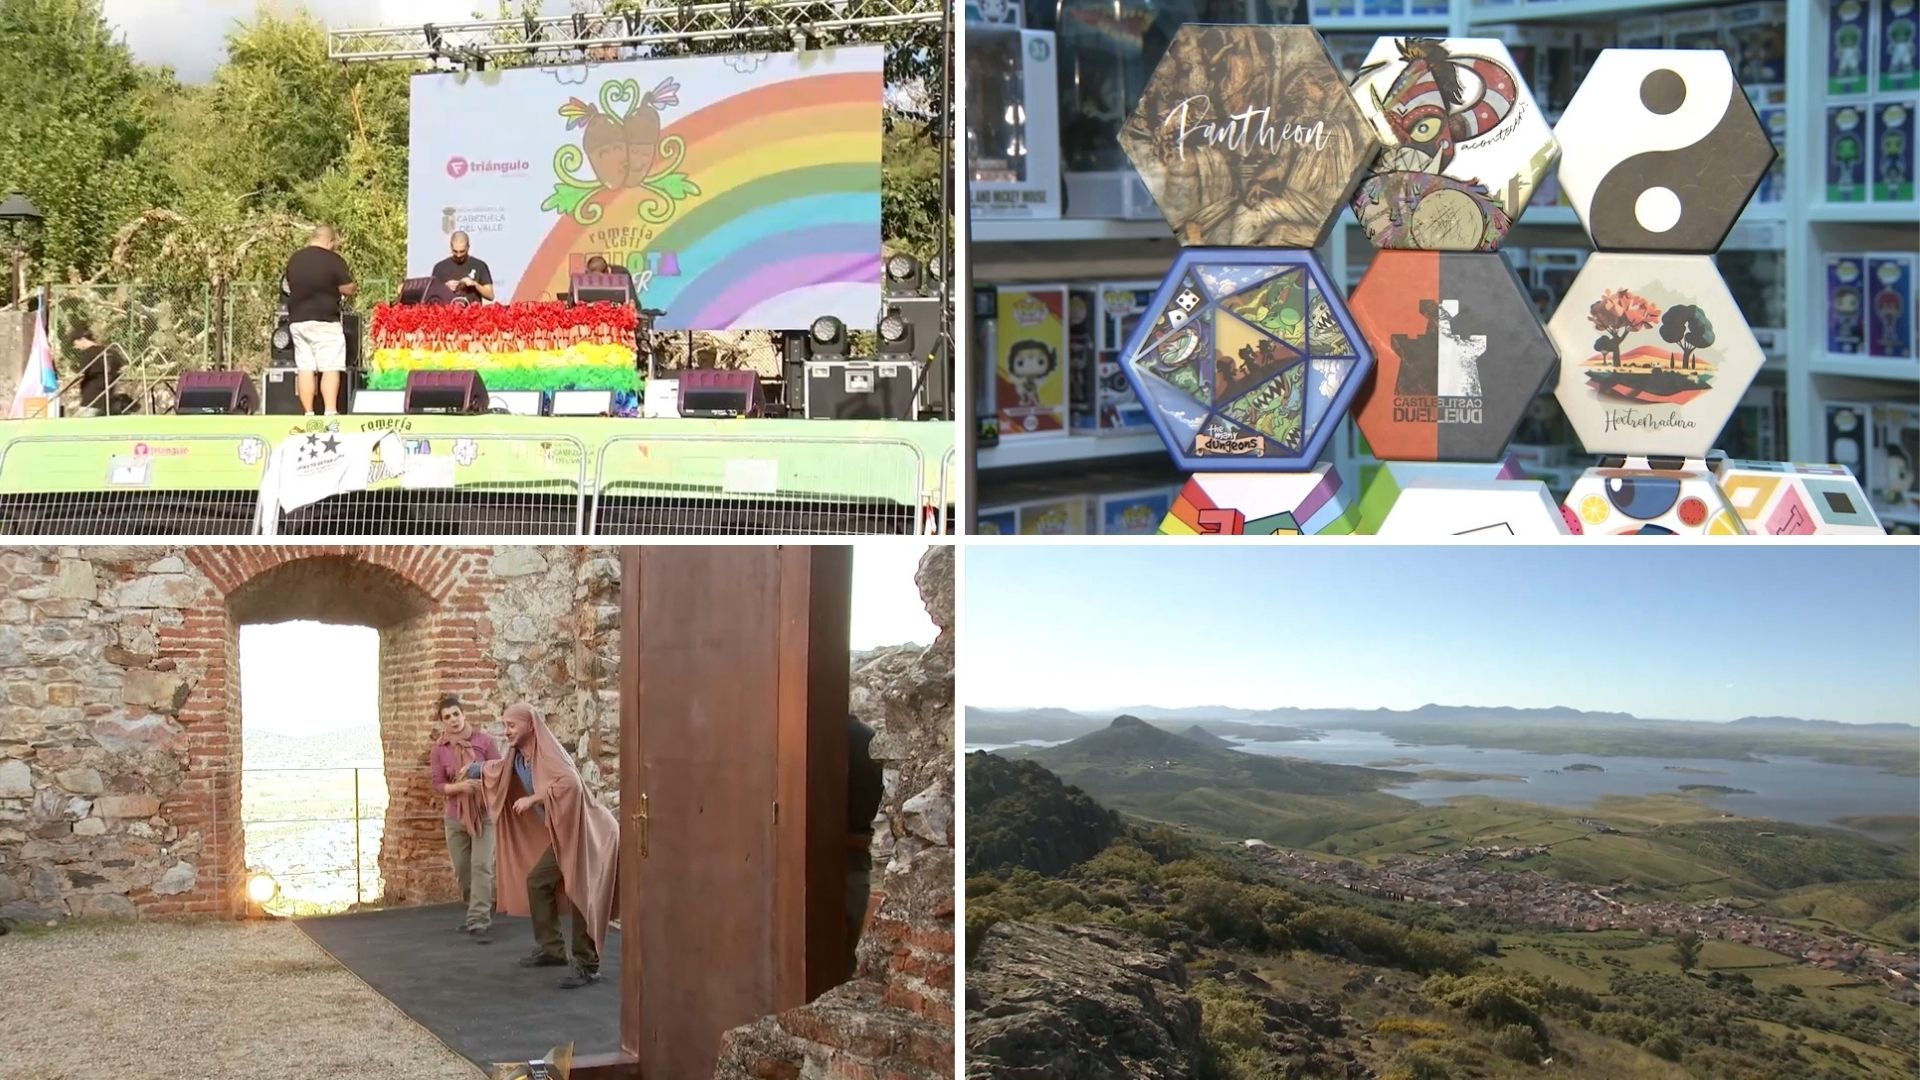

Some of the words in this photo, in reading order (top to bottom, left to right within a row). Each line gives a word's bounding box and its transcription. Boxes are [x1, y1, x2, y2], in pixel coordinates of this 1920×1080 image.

[1164, 95, 1333, 161] Pantheon
[470, 160, 530, 173] triángulo
[589, 223, 653, 243] romería
[605, 236, 640, 250] LGBTI
[1393, 397, 1437, 408] CASTLE
[1393, 408, 1437, 423] DUEL
[361, 417, 412, 433] romería
[1208, 424, 1224, 437] the
[1214, 432, 1239, 442] many
[1204, 438, 1258, 453] dungeons
